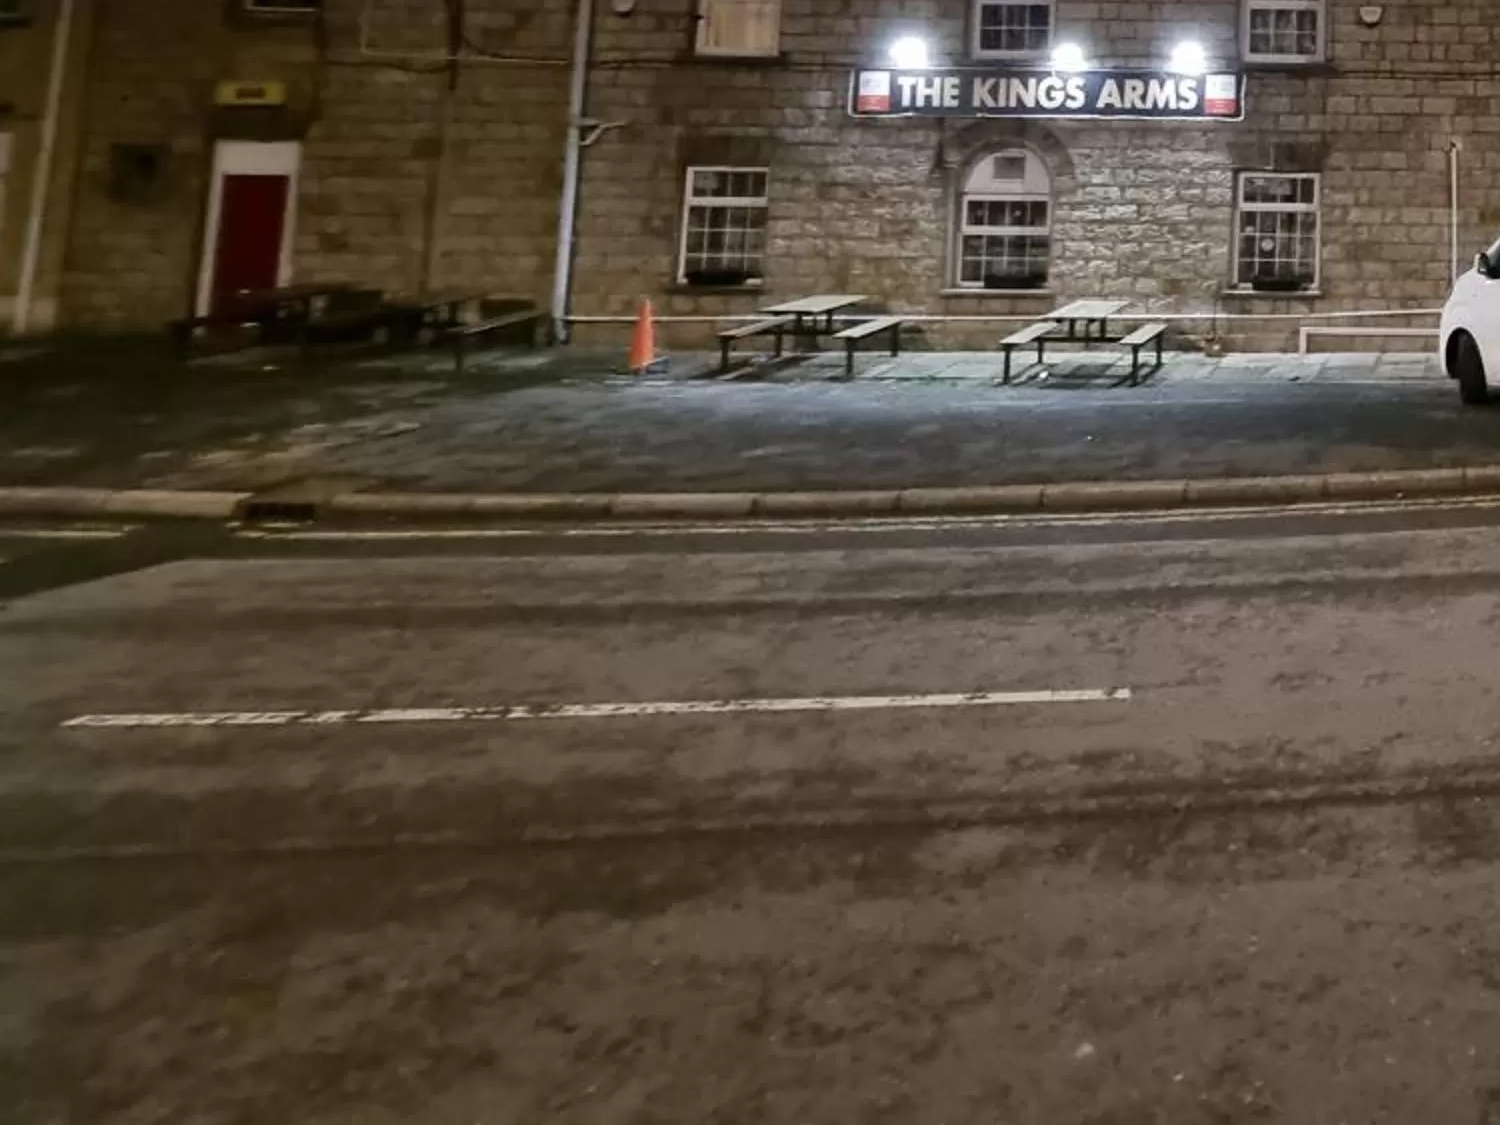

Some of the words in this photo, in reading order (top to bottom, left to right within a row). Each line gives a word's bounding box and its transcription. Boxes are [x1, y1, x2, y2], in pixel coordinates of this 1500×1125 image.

[898, 77, 960, 107] THE
[972, 76, 1086, 109] KINGS
[1096, 78, 1198, 110] ARMS
